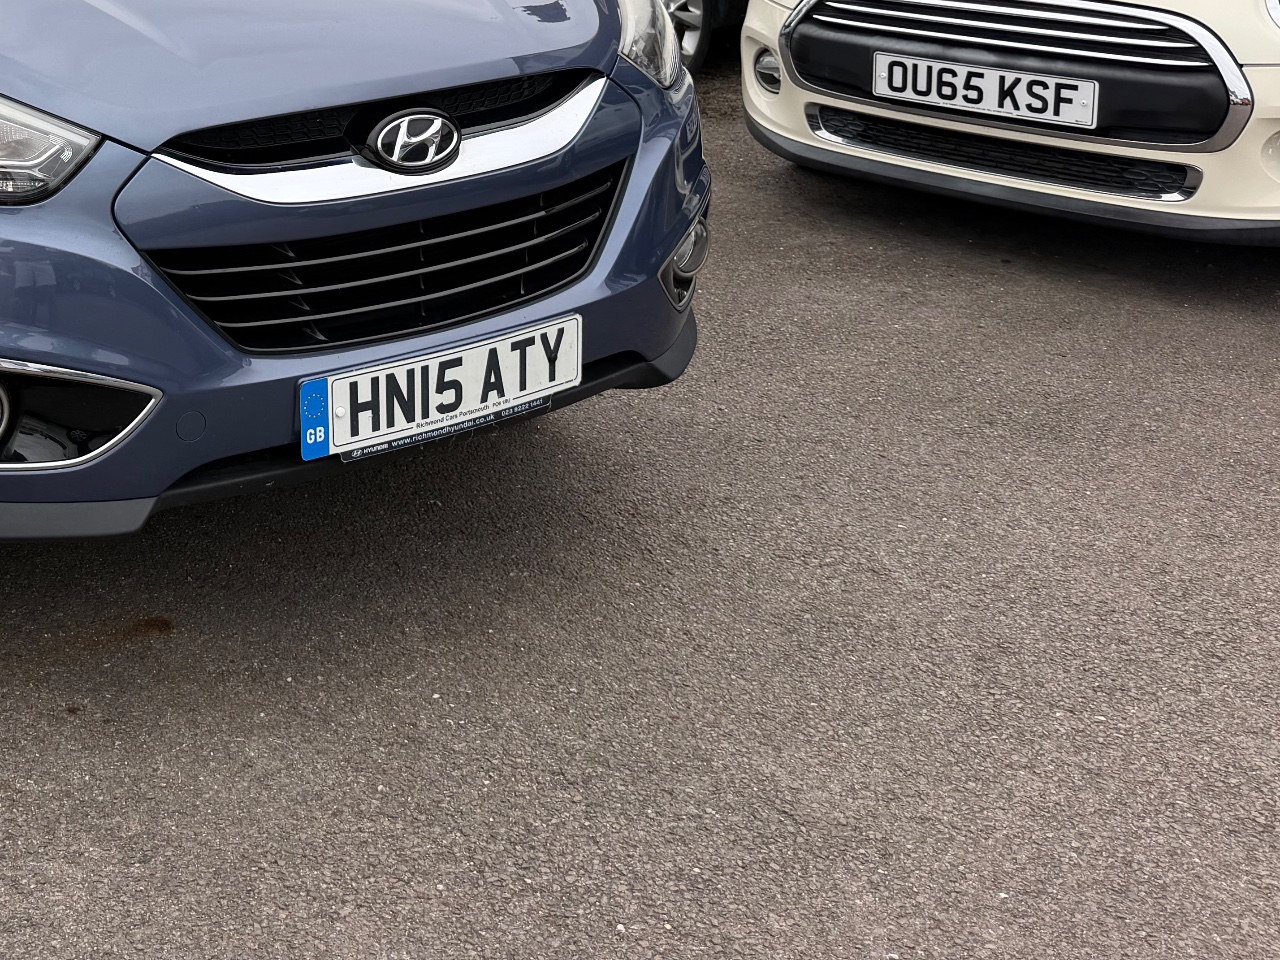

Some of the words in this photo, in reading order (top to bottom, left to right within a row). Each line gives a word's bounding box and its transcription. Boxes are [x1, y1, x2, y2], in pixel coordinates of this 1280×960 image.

[887, 60, 985, 106] OU65
[997, 75, 1079, 117] KSF
[349, 356, 464, 438] HN15
[479, 327, 566, 405] ATY
[306, 426, 326, 445] GB
[391, 412, 495, 447] www.richmondhyundai.co.uk
[501, 408, 513, 417] 023
[530, 398, 543, 408] 1441
[416, 417, 445, 430] Richmond
[445, 413, 458, 423] Cars
[458, 404, 490, 418] Portsmouth
